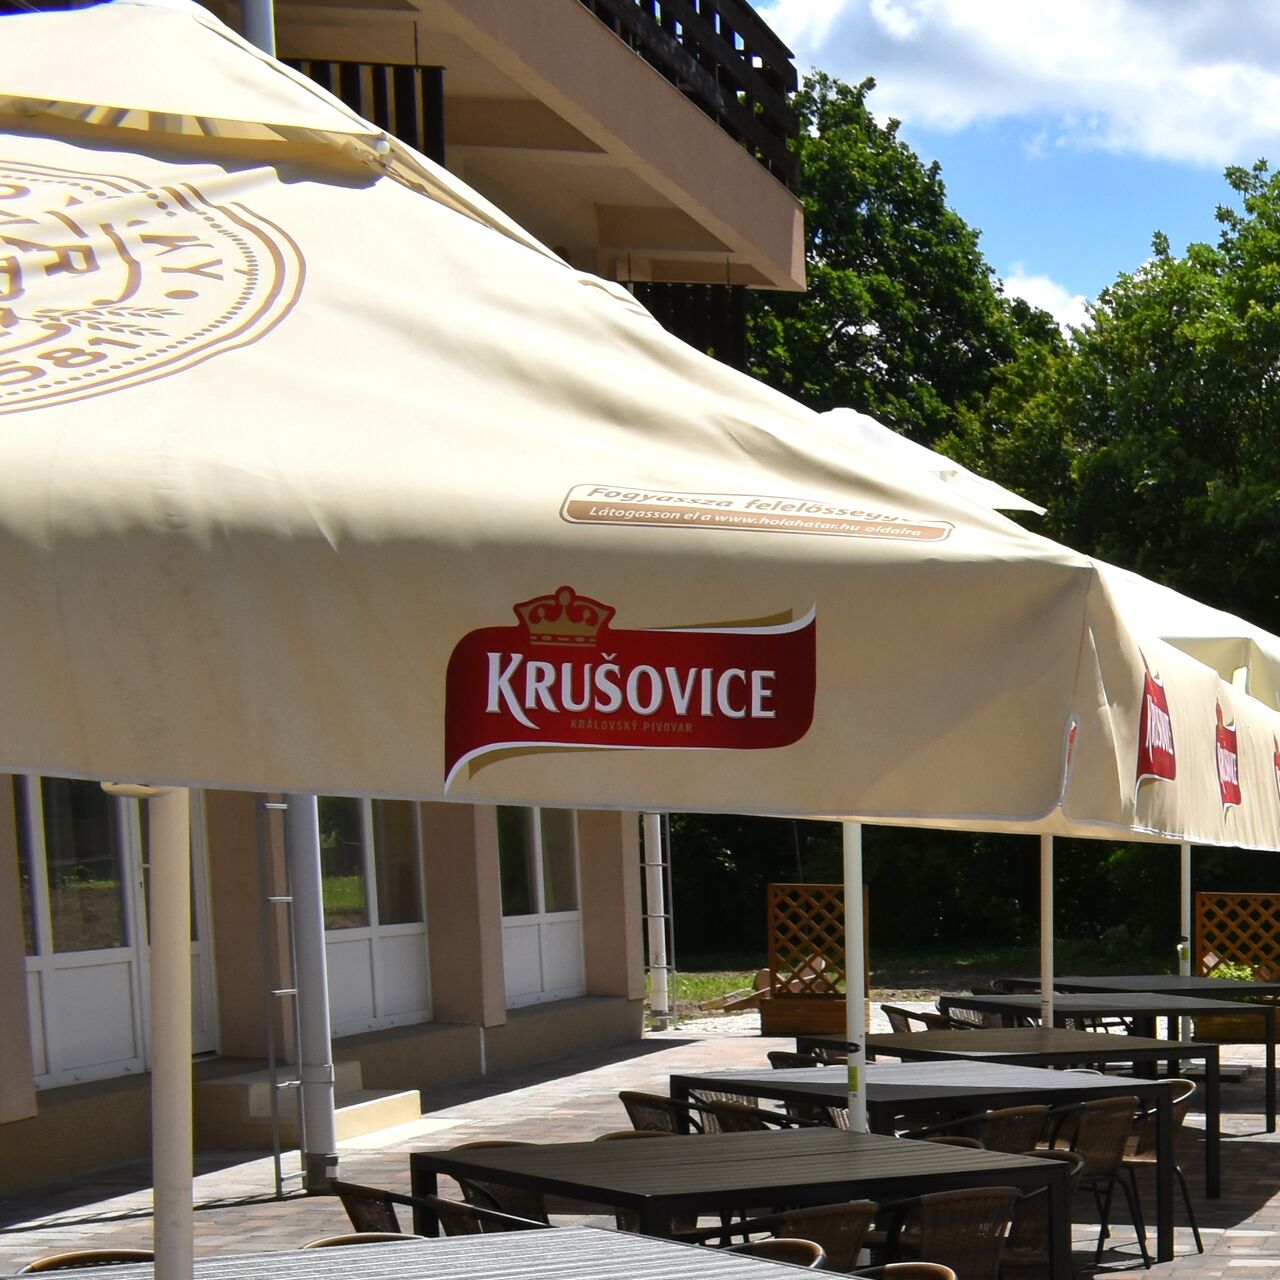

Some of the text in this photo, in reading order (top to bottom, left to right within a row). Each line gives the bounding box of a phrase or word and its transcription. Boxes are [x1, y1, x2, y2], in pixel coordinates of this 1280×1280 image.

[587, 487, 733, 508] Fogyassza
[589, 506, 681, 521] Látogasson
[684, 511, 700, 520] el
[714, 514, 861, 532] www.holahatar.hu
[865, 524, 922, 537] oldaira
[643, 721, 693, 733] PIVOVAR
